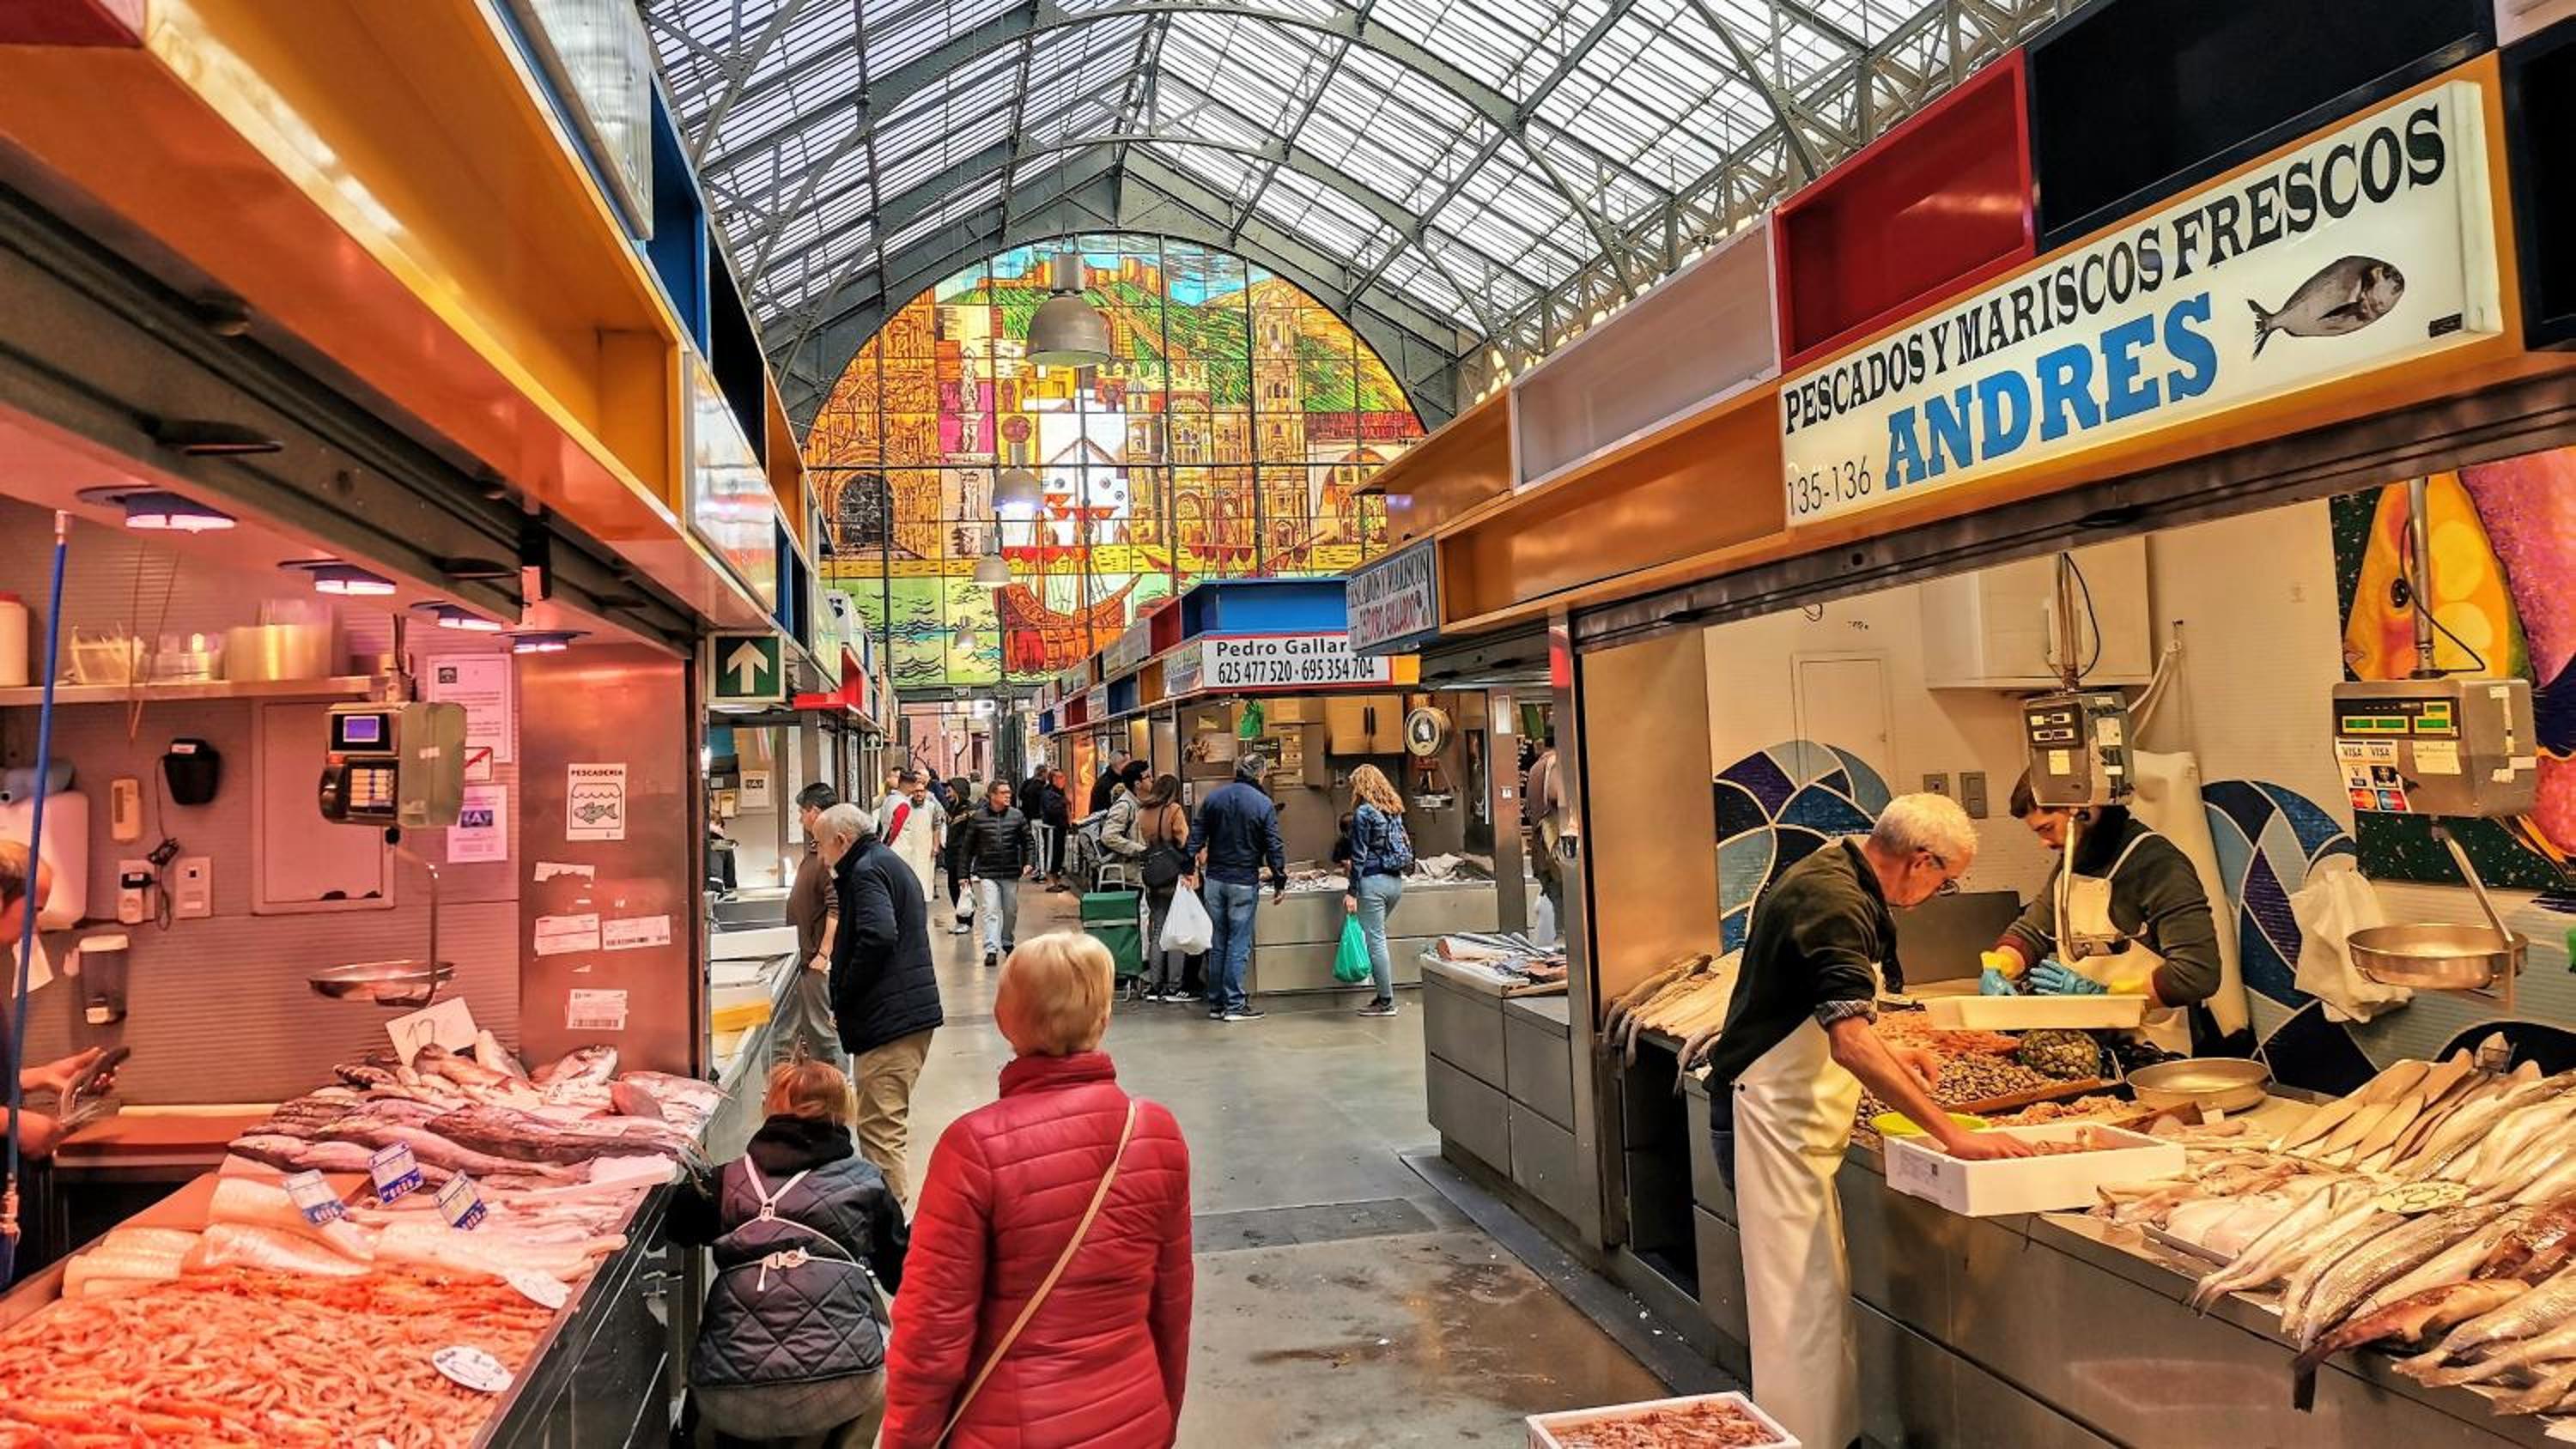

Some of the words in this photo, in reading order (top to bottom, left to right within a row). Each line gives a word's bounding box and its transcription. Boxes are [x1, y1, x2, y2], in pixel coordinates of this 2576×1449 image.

[1784, 332, 1926, 435] PESCADOS
[1929, 321, 1950, 375] Y
[1957, 225, 2163, 367] MARISCOS
[2172, 103, 2445, 281] FRESCOS
[1885, 292, 2218, 491] ANDRES
[1788, 456, 1871, 516] 135-136
[1217, 640, 1277, 657] Pedro
[1285, 638, 1348, 656] Gallar
[1218, 661, 1241, 684] 625
[1244, 660, 1267, 683] 477
[1270, 659, 1292, 682] 520
[1301, 658, 1324, 682] 695
[1327, 658, 1350, 681] 354
[1352, 656, 1374, 679] 704
[2342, 746, 2363, 757] VISA
[2370, 746, 2391, 757] VISA
